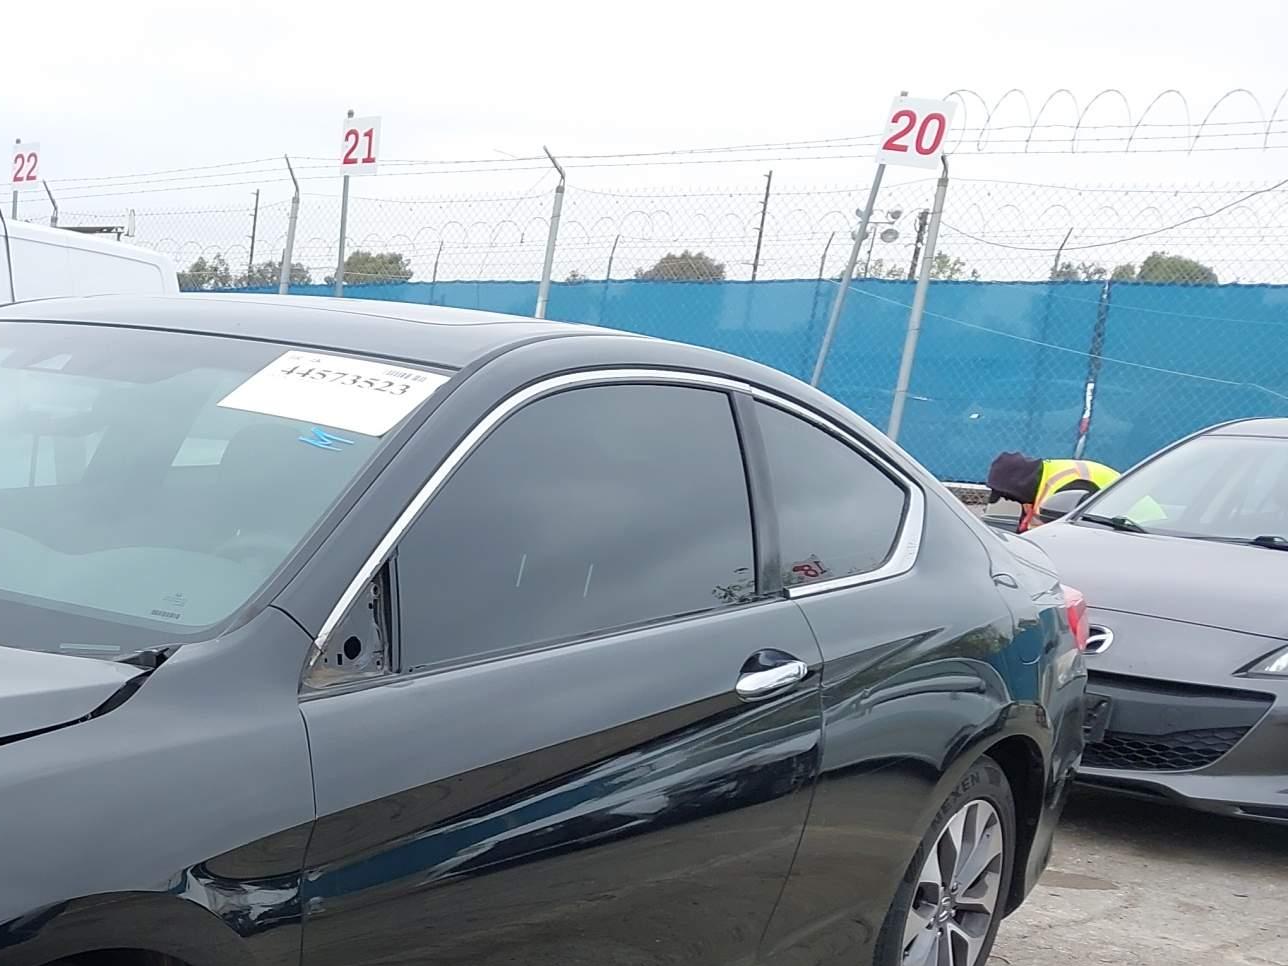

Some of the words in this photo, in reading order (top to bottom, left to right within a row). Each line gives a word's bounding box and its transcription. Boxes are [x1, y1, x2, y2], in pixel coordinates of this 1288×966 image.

[342, 127, 376, 164] 21
[881, 109, 946, 155] 20
[13, 152, 38, 182] 22
[280, 364, 411, 396] 44573523
